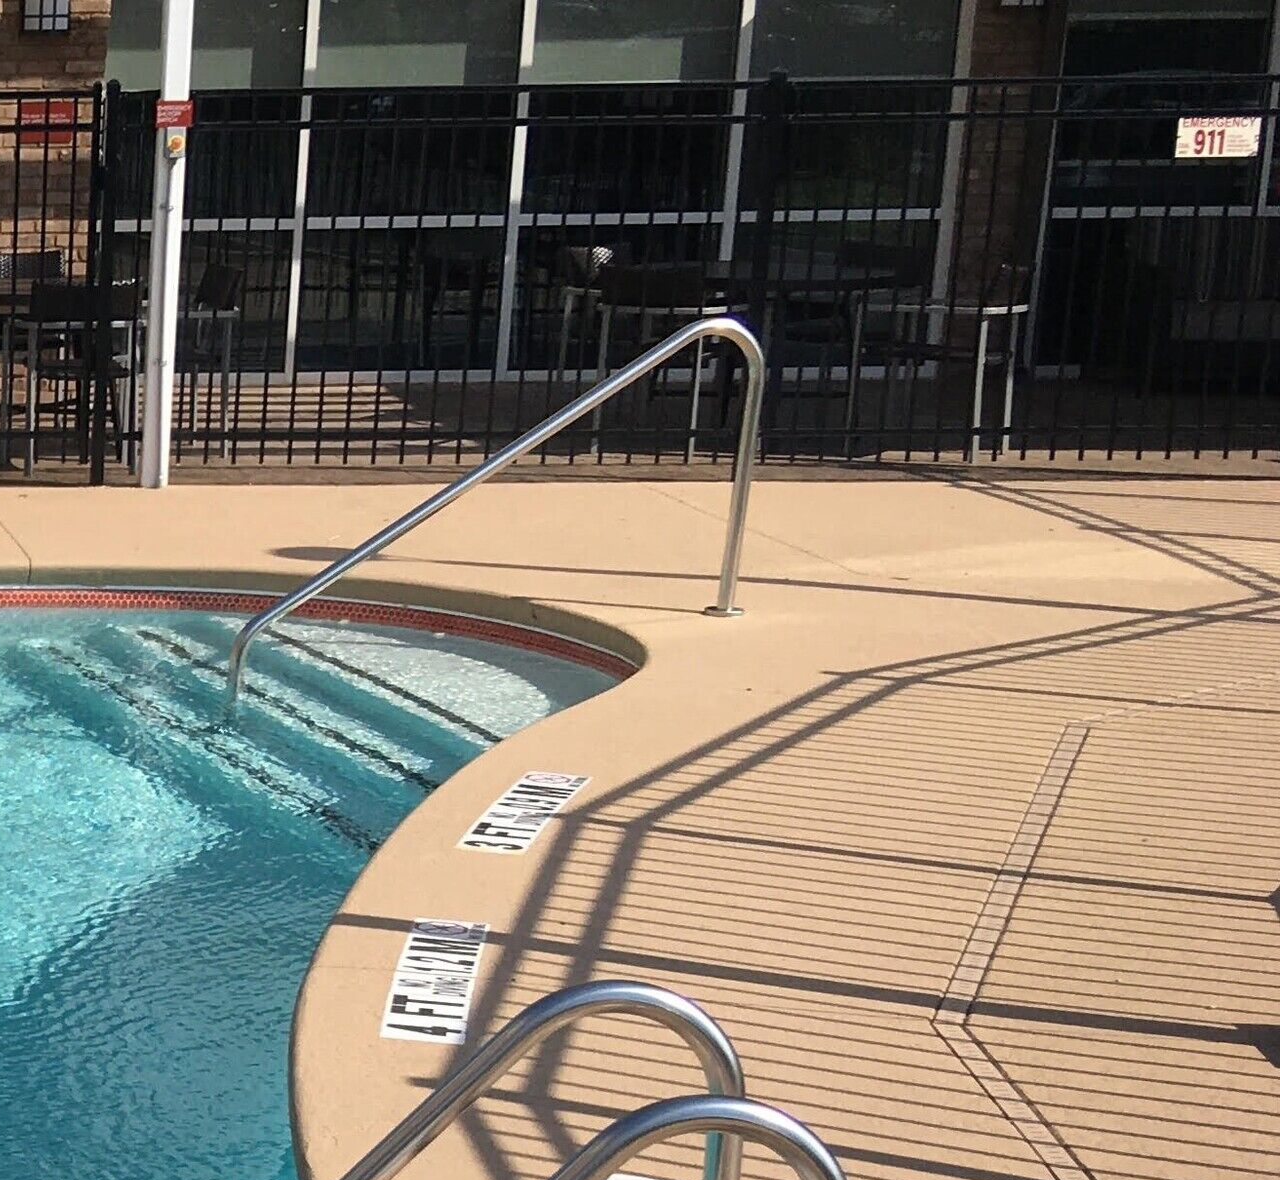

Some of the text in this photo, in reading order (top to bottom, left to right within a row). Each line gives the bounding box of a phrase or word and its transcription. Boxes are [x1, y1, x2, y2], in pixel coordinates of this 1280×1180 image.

[1183, 117, 1257, 128] EMERGENCY
[1193, 129, 1226, 155] 911
[511, 783, 576, 799] M
[471, 822, 537, 840] FT
[464, 840, 524, 850] 3
[403, 937, 480, 974] 1.2 M
[386, 994, 464, 1036] 4 FT
